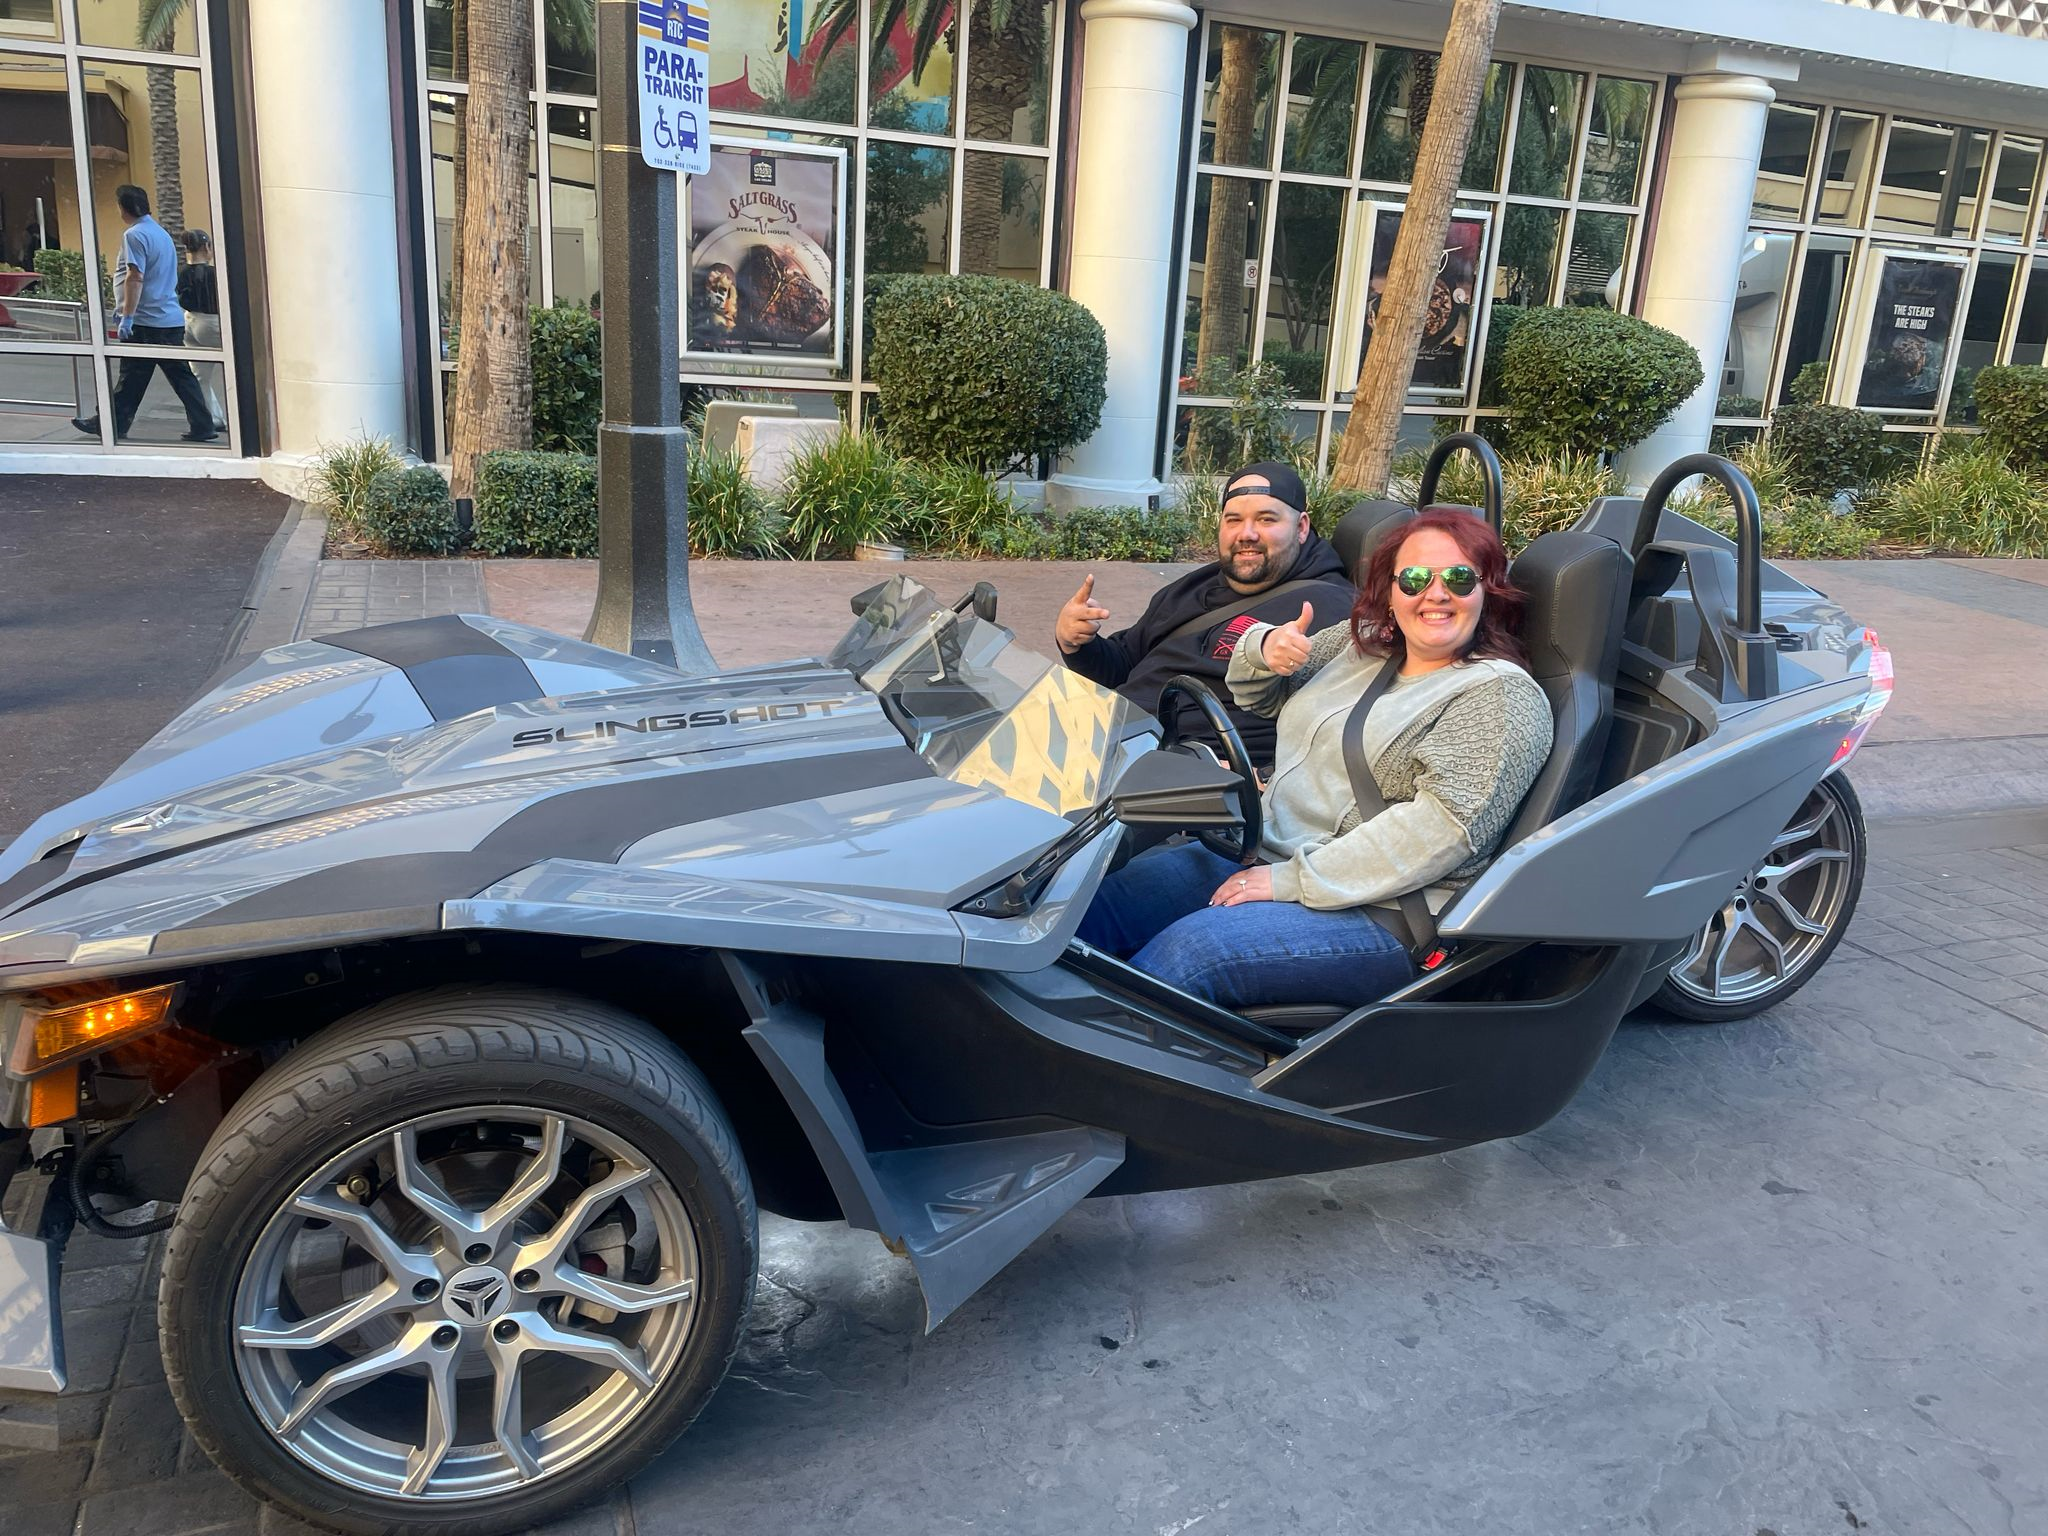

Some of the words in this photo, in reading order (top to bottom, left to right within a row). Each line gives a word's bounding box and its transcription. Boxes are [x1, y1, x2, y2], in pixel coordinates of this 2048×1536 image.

[667, 19, 683, 40] RTC
[645, 45, 704, 84] PARA-
[645, 74, 704, 105] TRANSIT
[728, 191, 798, 224] SALTGRASS
[1893, 304, 1908, 316] THE
[1907, 305, 1935, 318] STEAKS
[1894, 317, 1910, 329] ARE
[1909, 318, 1928, 330] HIGH
[513, 700, 844, 749] SLINGSHOT
